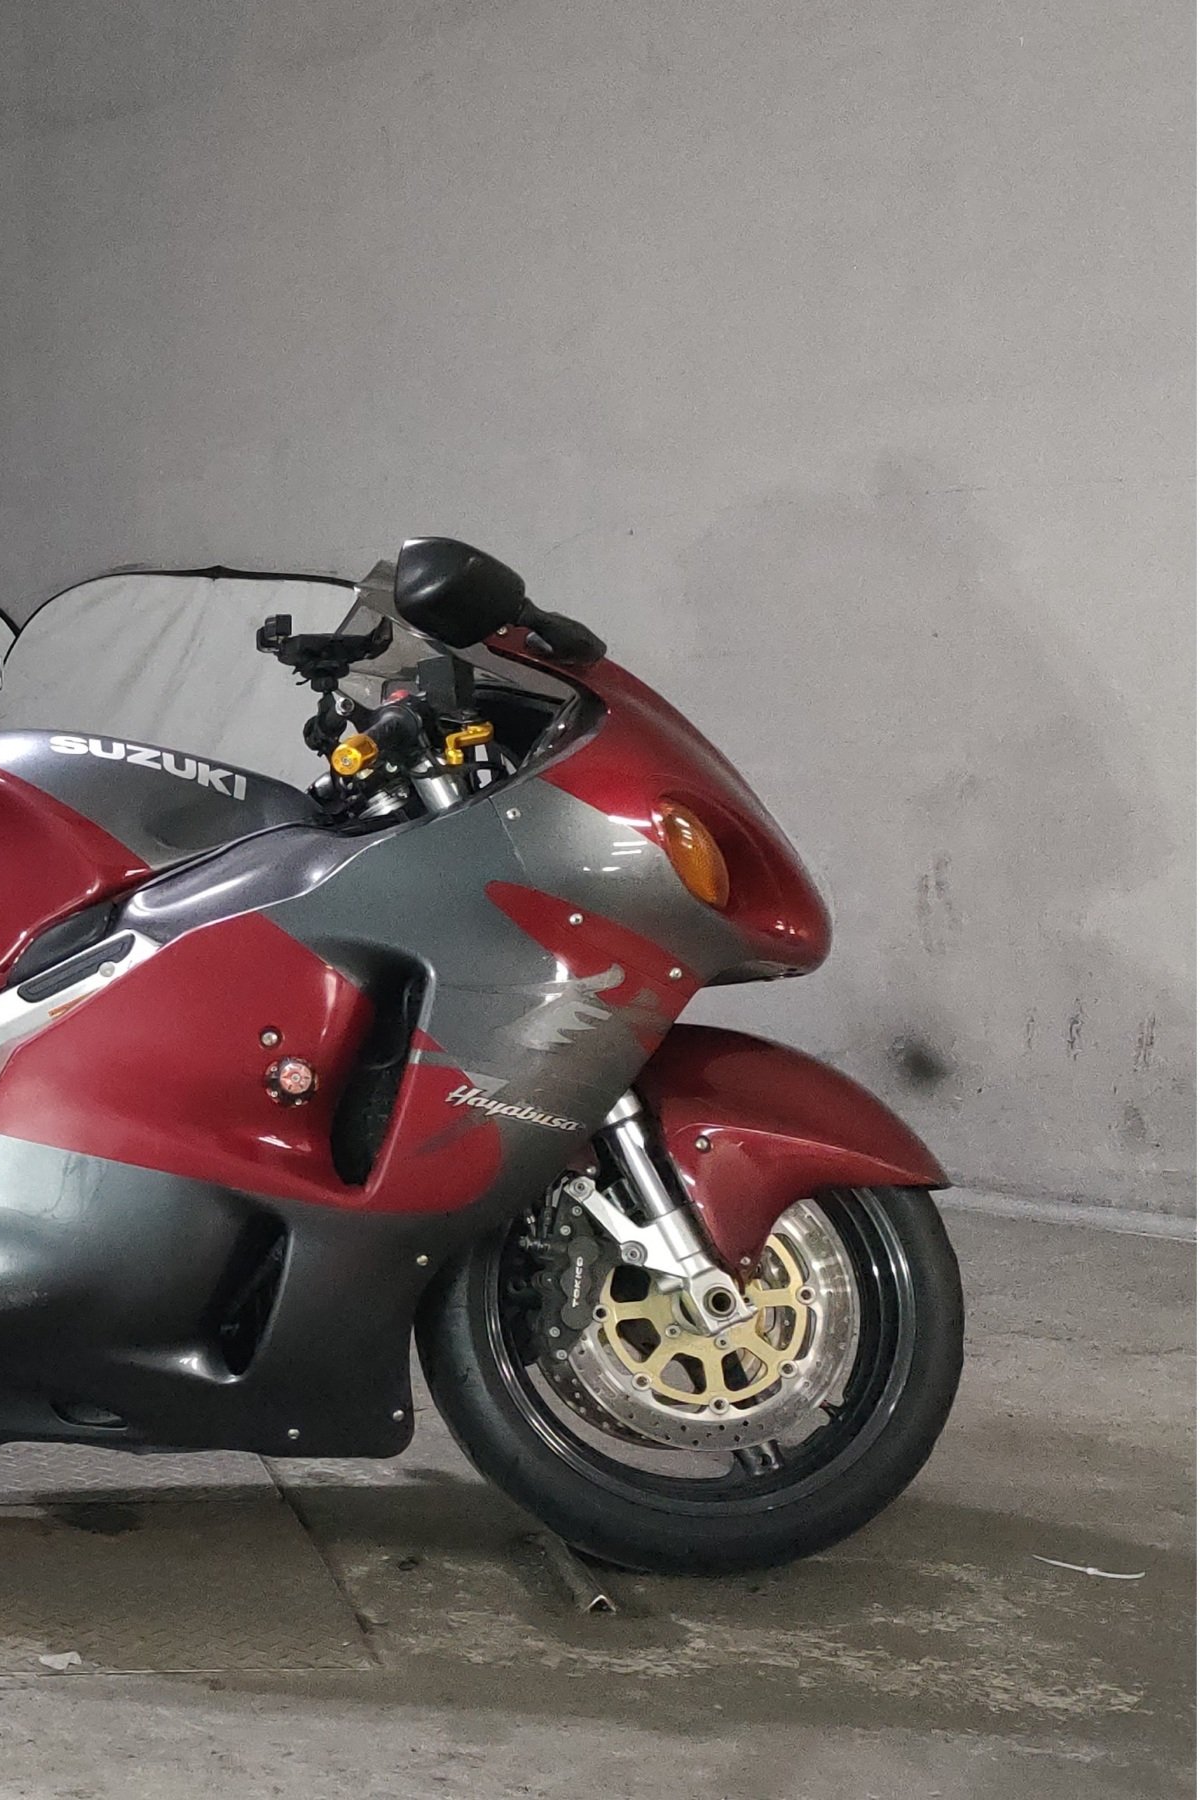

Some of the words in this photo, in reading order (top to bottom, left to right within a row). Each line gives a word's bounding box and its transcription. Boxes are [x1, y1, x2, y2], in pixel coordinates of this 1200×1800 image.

[49, 735, 247, 801] SUZUKI
[444, 1084, 584, 1132] Hayabusa
[572, 1256, 584, 1308] TOKICO
